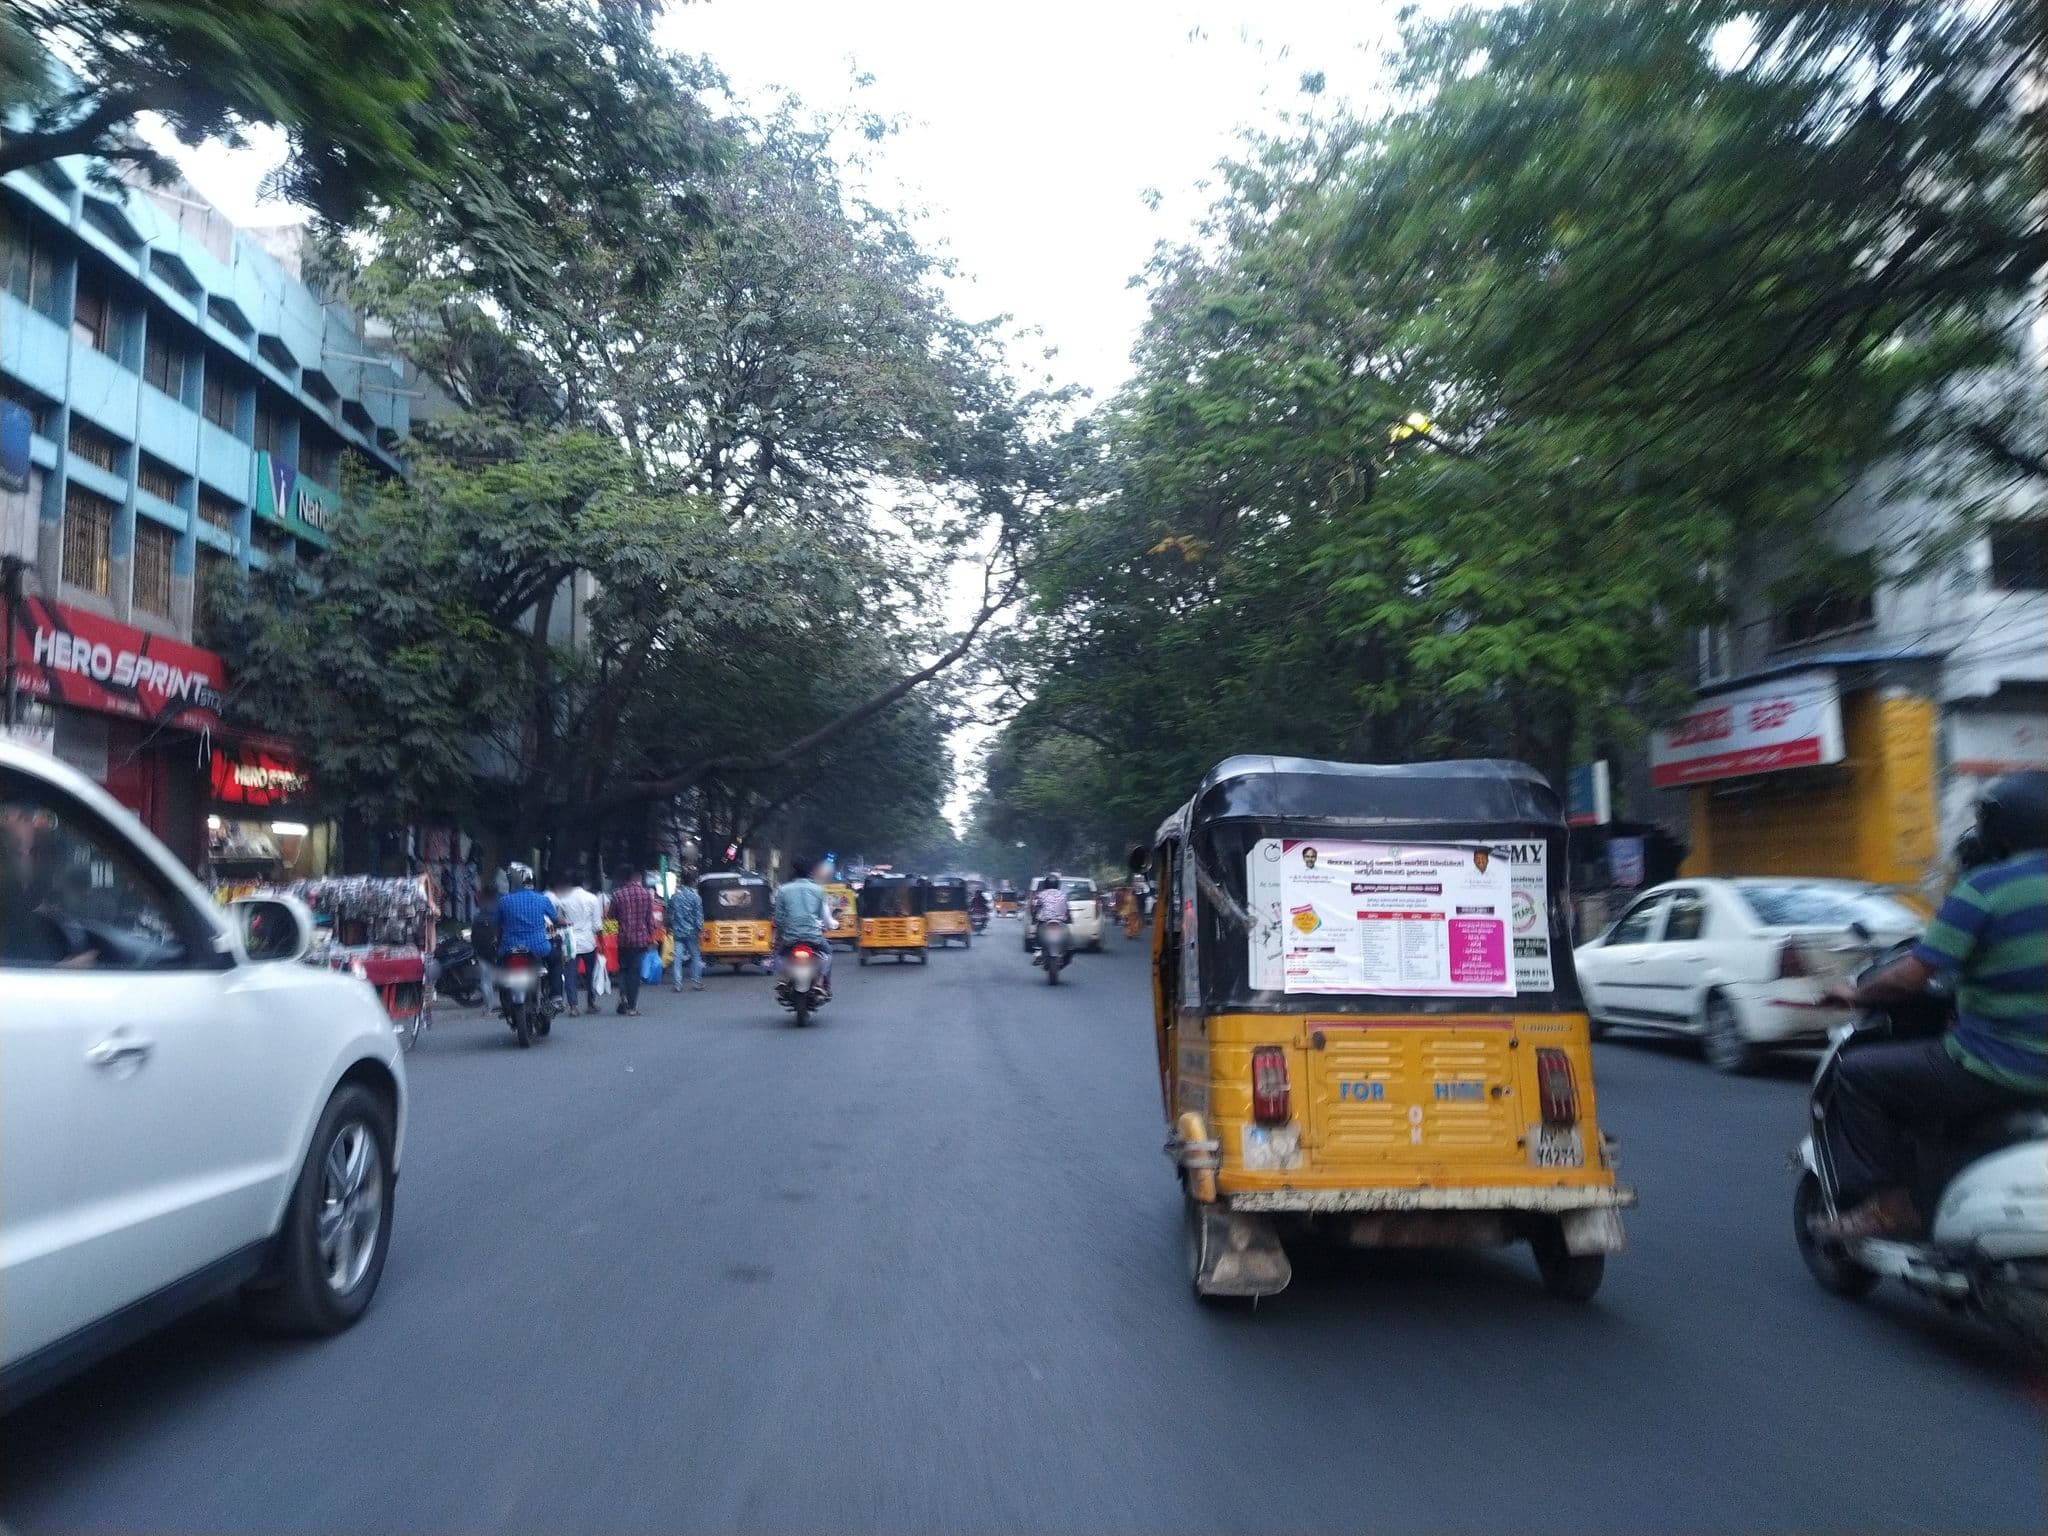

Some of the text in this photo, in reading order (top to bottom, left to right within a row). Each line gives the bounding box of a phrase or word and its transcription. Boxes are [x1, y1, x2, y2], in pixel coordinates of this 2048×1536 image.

[33, 625, 112, 681] HERO
[112, 650, 208, 705] SPRINT
[1340, 1081, 1384, 1101] FOR
